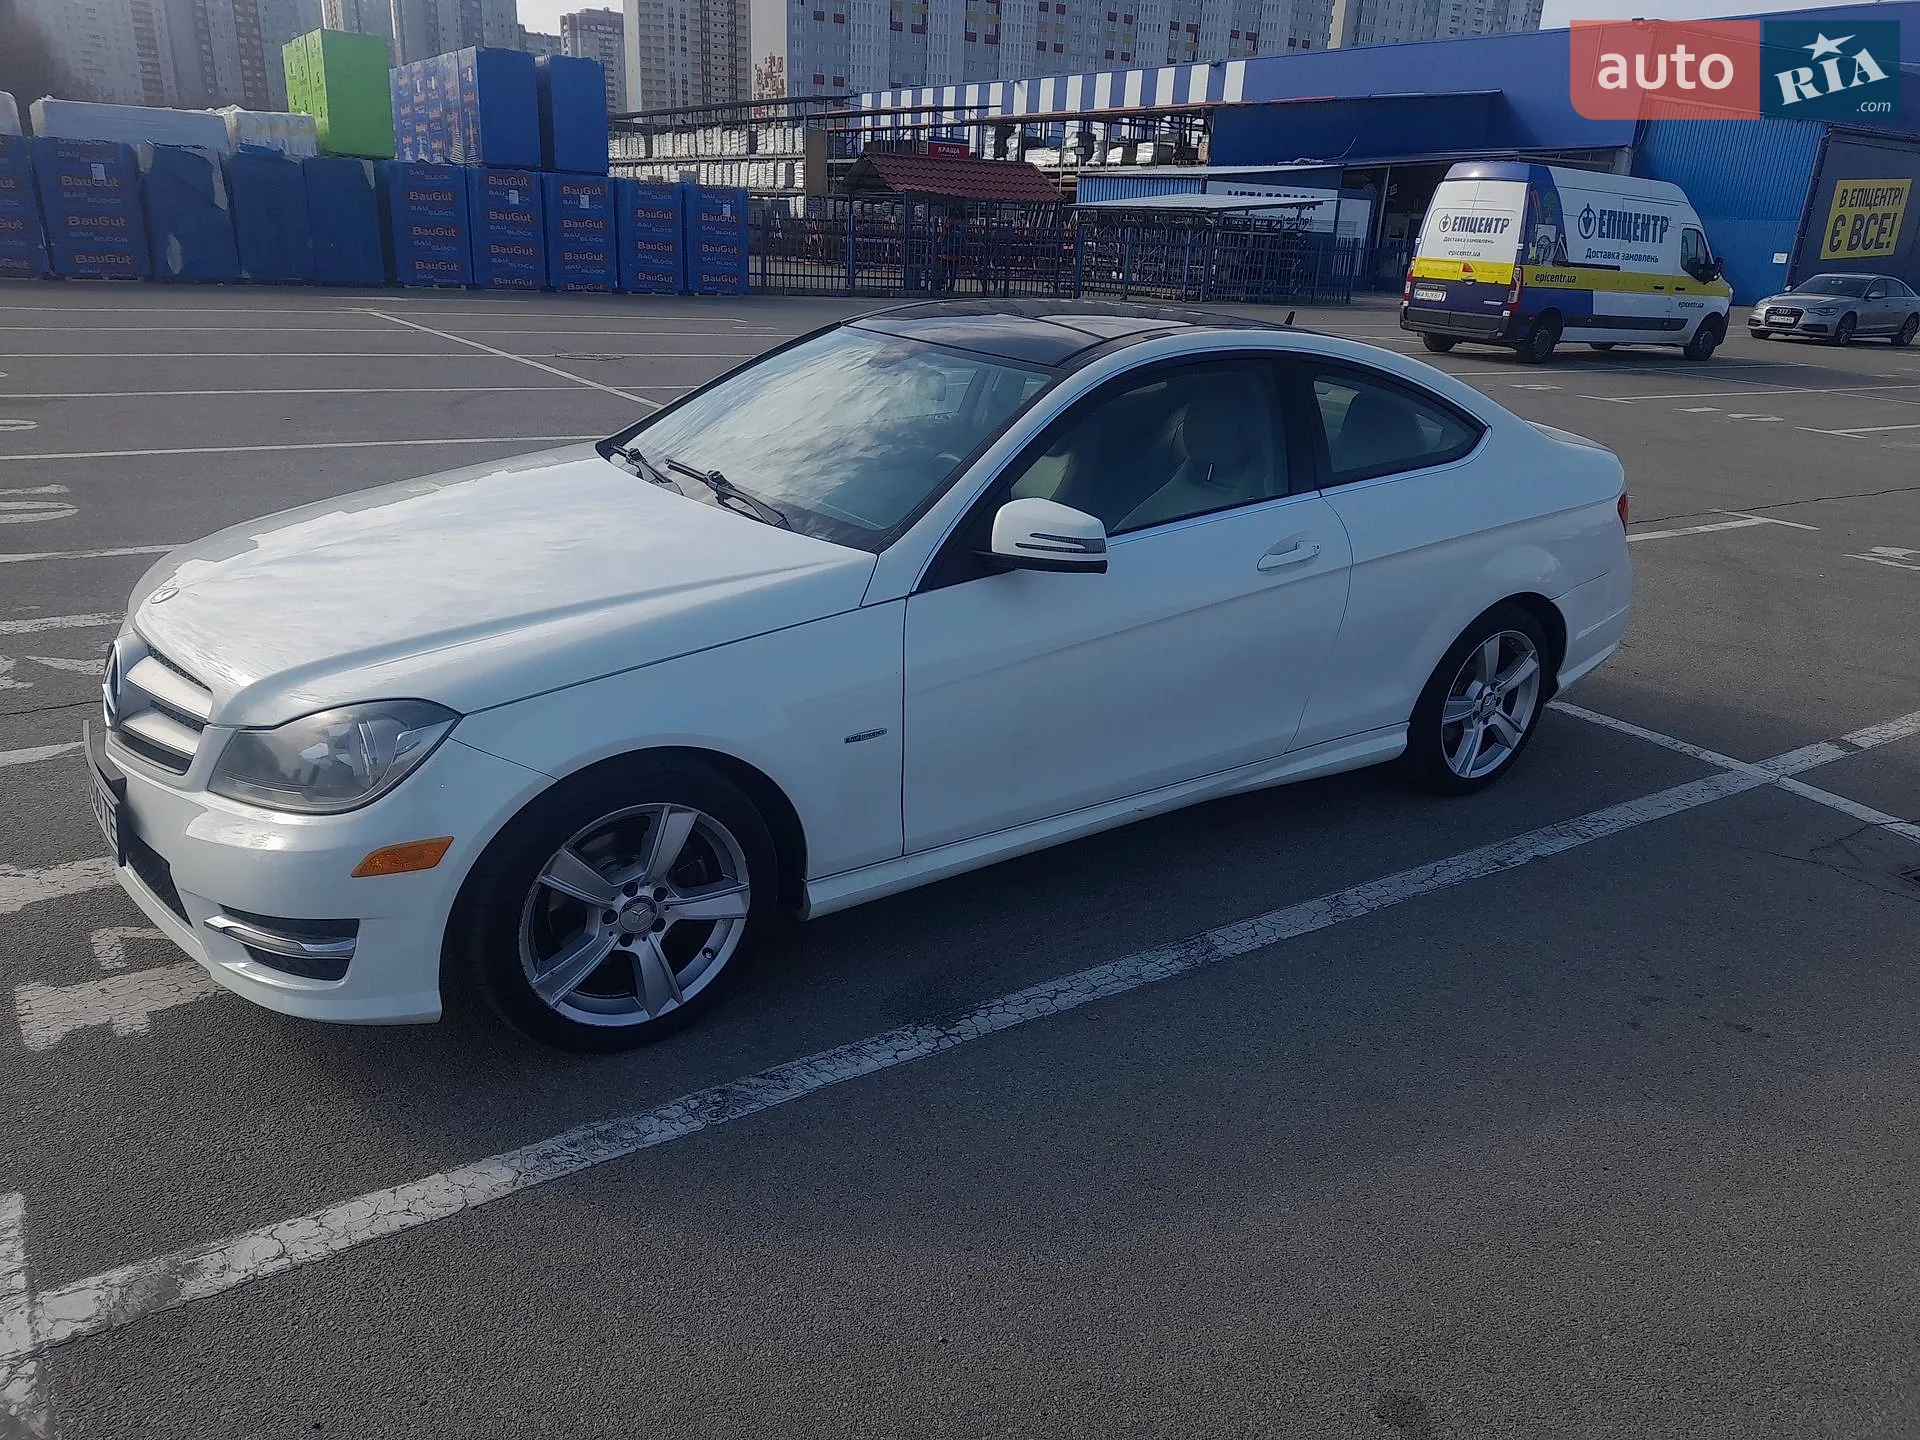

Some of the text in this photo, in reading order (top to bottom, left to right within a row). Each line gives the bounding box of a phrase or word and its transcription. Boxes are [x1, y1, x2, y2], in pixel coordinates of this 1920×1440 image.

[488, 176, 528, 186] BauGut
[562, 185, 603, 196] BauGut
[409, 191, 454, 202] BauGut
[1839, 188, 1849, 208] В
[488, 211, 532, 222] BauGut
[637, 209, 673, 220] BauGut
[701, 212, 737, 223] BauGut
[67, 216, 127, 227] BauGut
[563, 219, 605, 229] BauGut
[1451, 216, 1510, 234] ЕПІЦЕНТР
[1598, 209, 1669, 244] ЕПІЦЕНТР
[412, 226, 457, 238] BauGut
[1829, 213, 1898, 252] Є ВСЕ!
[490, 244, 535, 256] BauGut
[637, 241, 673, 252] BauGut
[702, 244, 738, 255] BauGut
[564, 252, 605, 262] BauGut
[1448, 249, 1481, 257] epicentr.ua
[1585, 248, 1659, 263] Доставка замовлень
[73, 254, 134, 265] BauGut
[415, 261, 460, 272] BauGut
[638, 272, 673, 283] BauGut
[702, 274, 739, 284] BauGut
[1535, 271, 1577, 284] epicentr.ua
